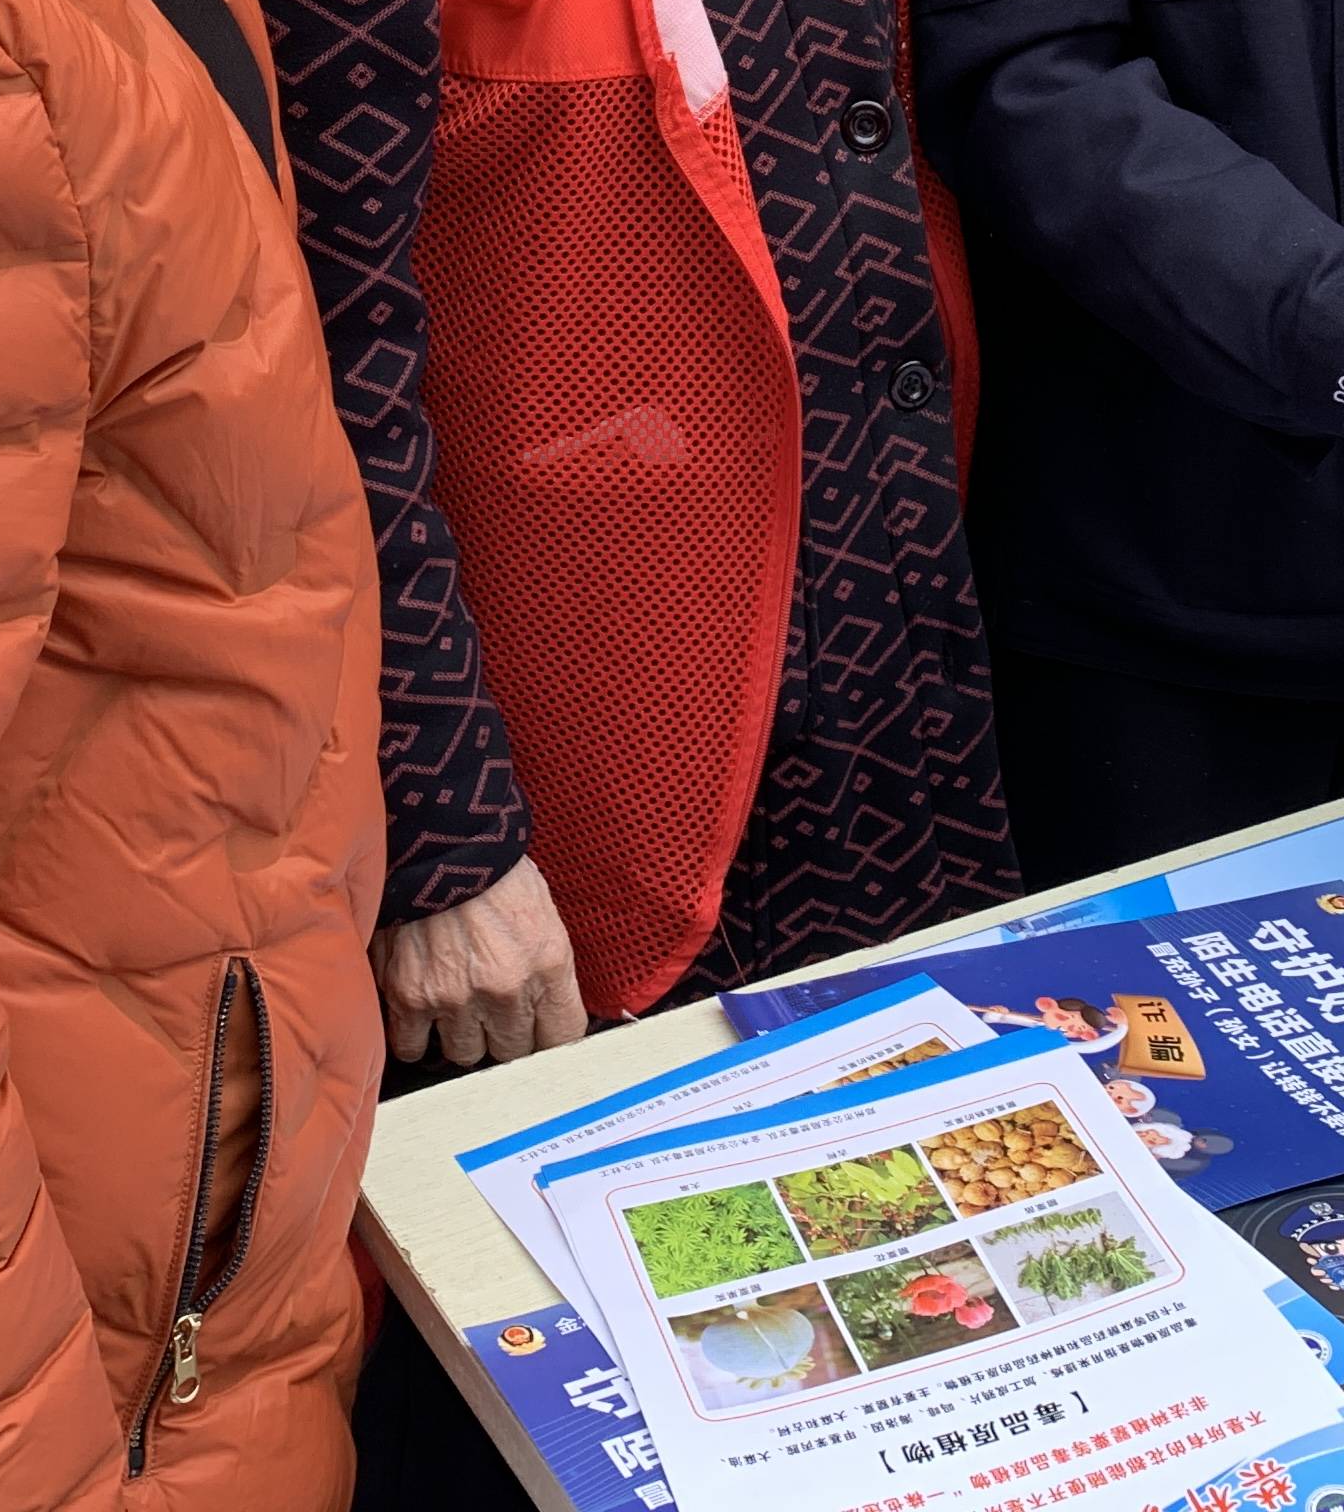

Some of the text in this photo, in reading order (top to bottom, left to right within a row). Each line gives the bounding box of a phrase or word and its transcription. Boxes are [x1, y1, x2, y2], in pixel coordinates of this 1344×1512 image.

[1137, 1001, 1185, 1064] 诈骗
[878, 1390, 1090, 1475] 【毒品原植物】
